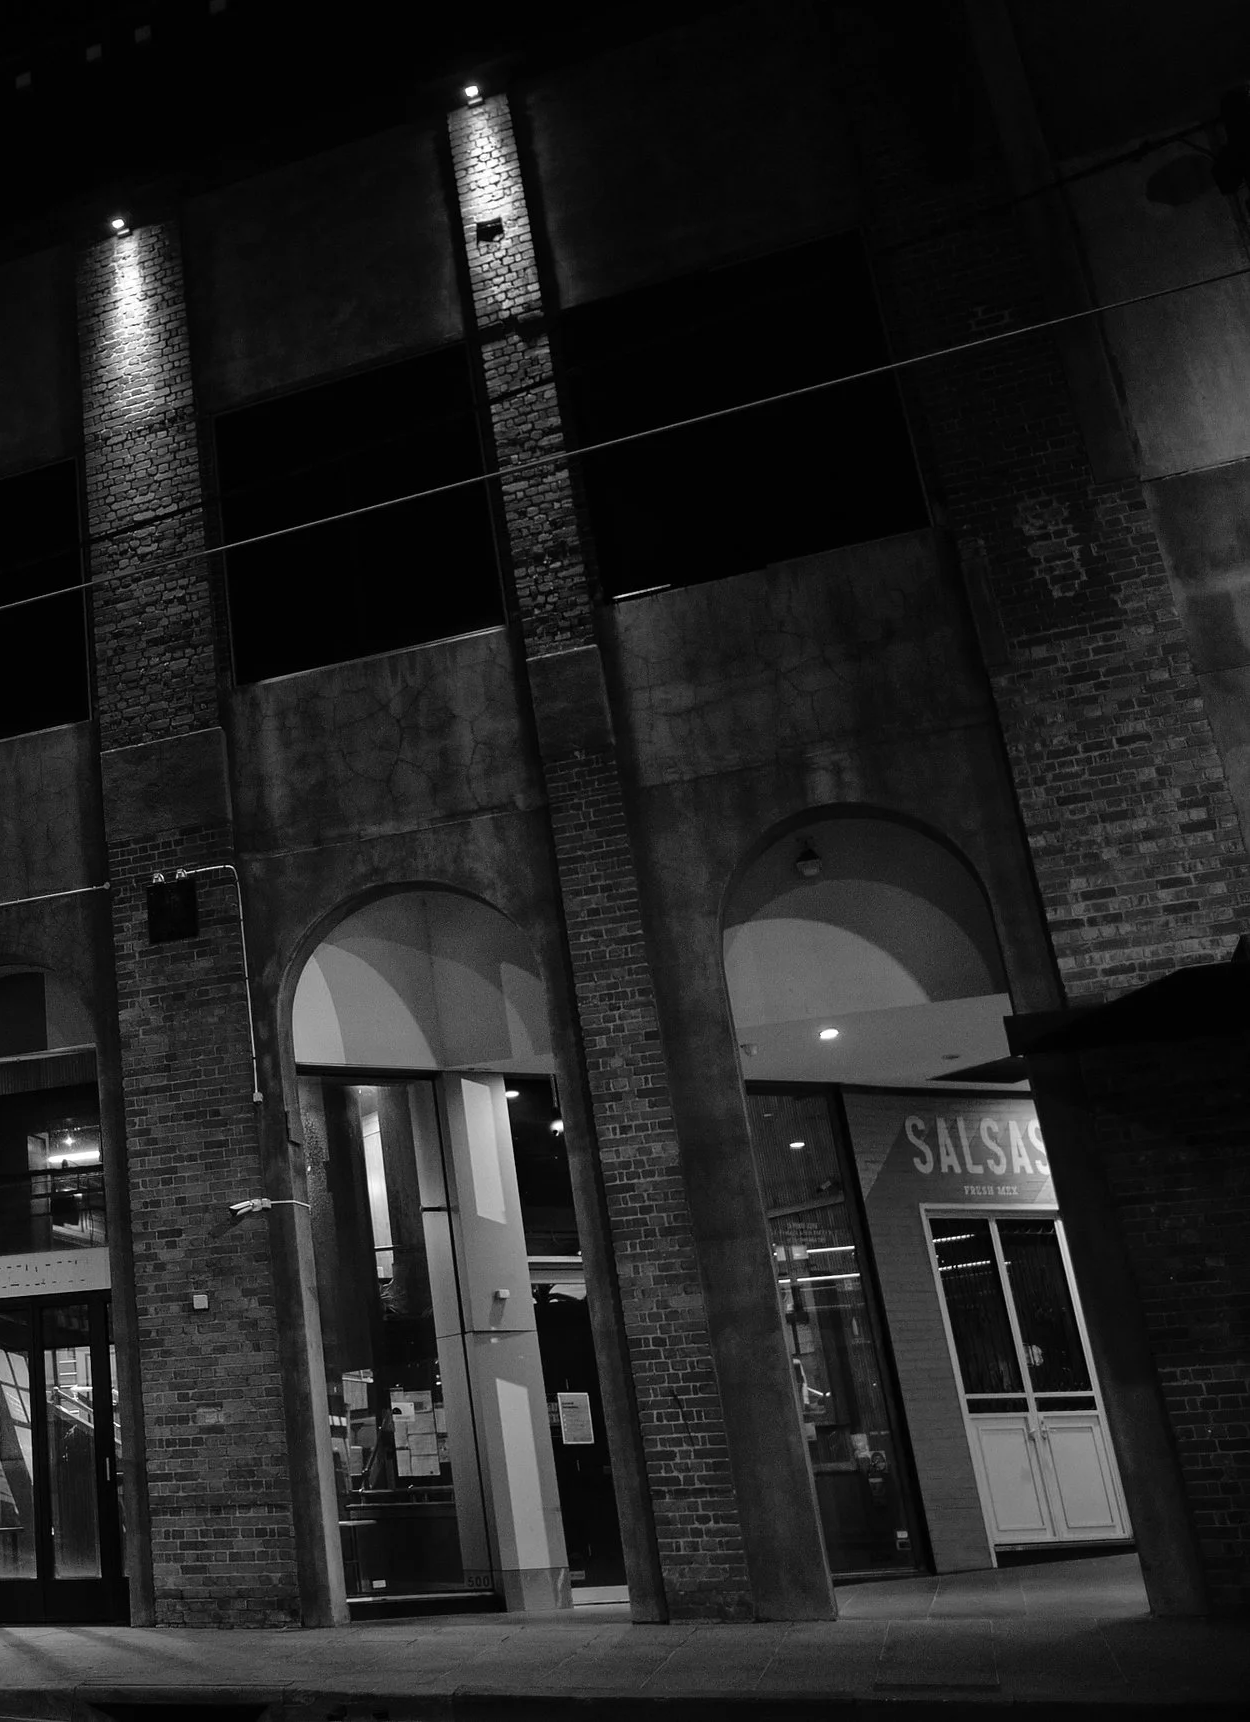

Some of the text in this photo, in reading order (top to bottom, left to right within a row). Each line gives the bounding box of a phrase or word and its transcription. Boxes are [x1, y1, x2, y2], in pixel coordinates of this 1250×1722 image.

[904, 1115, 1051, 1176] SALSAS
[963, 1185, 1019, 1196] FRESH MEX
[468, 1575, 490, 1588] 500
